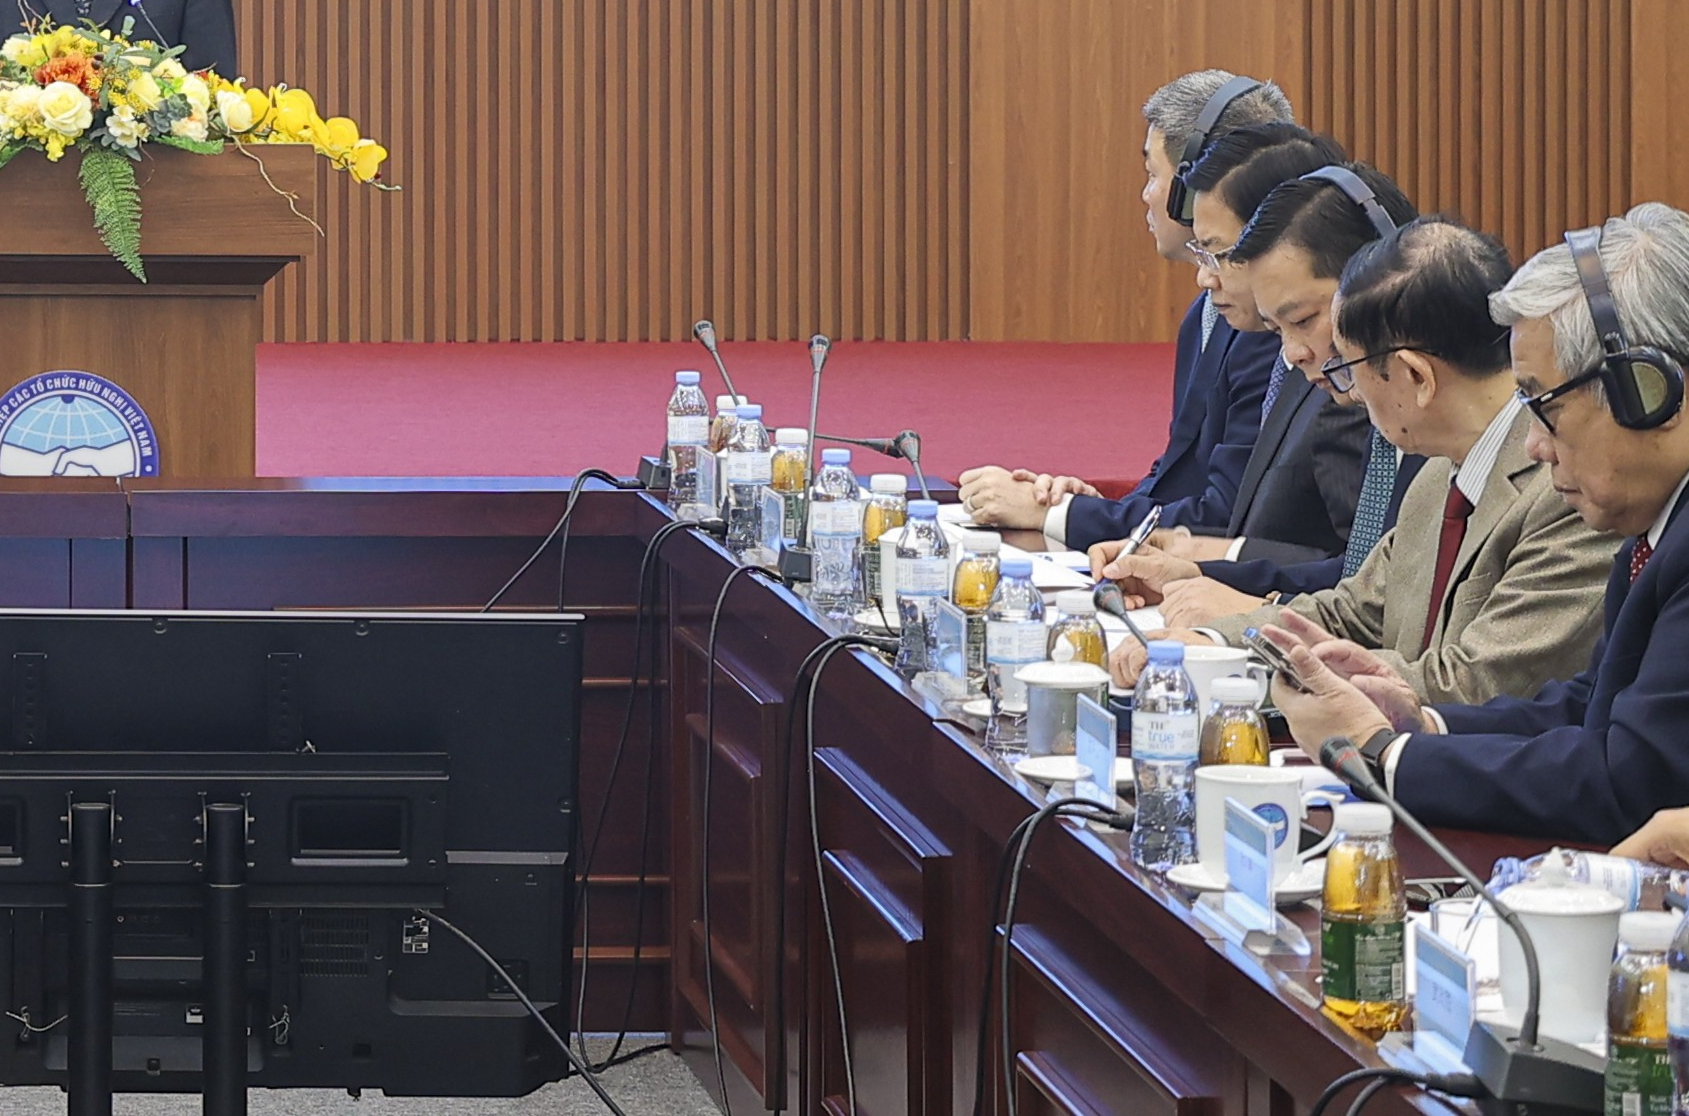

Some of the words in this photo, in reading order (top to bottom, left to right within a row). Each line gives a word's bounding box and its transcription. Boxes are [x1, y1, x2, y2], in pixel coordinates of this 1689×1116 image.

[8, 388, 31, 409] CÁC
[101, 387, 128, 412] NGHỊ
[124, 406, 145, 431] VIỆT
[137, 430, 153, 457] NAM
[1147, 730, 1175, 744] true
